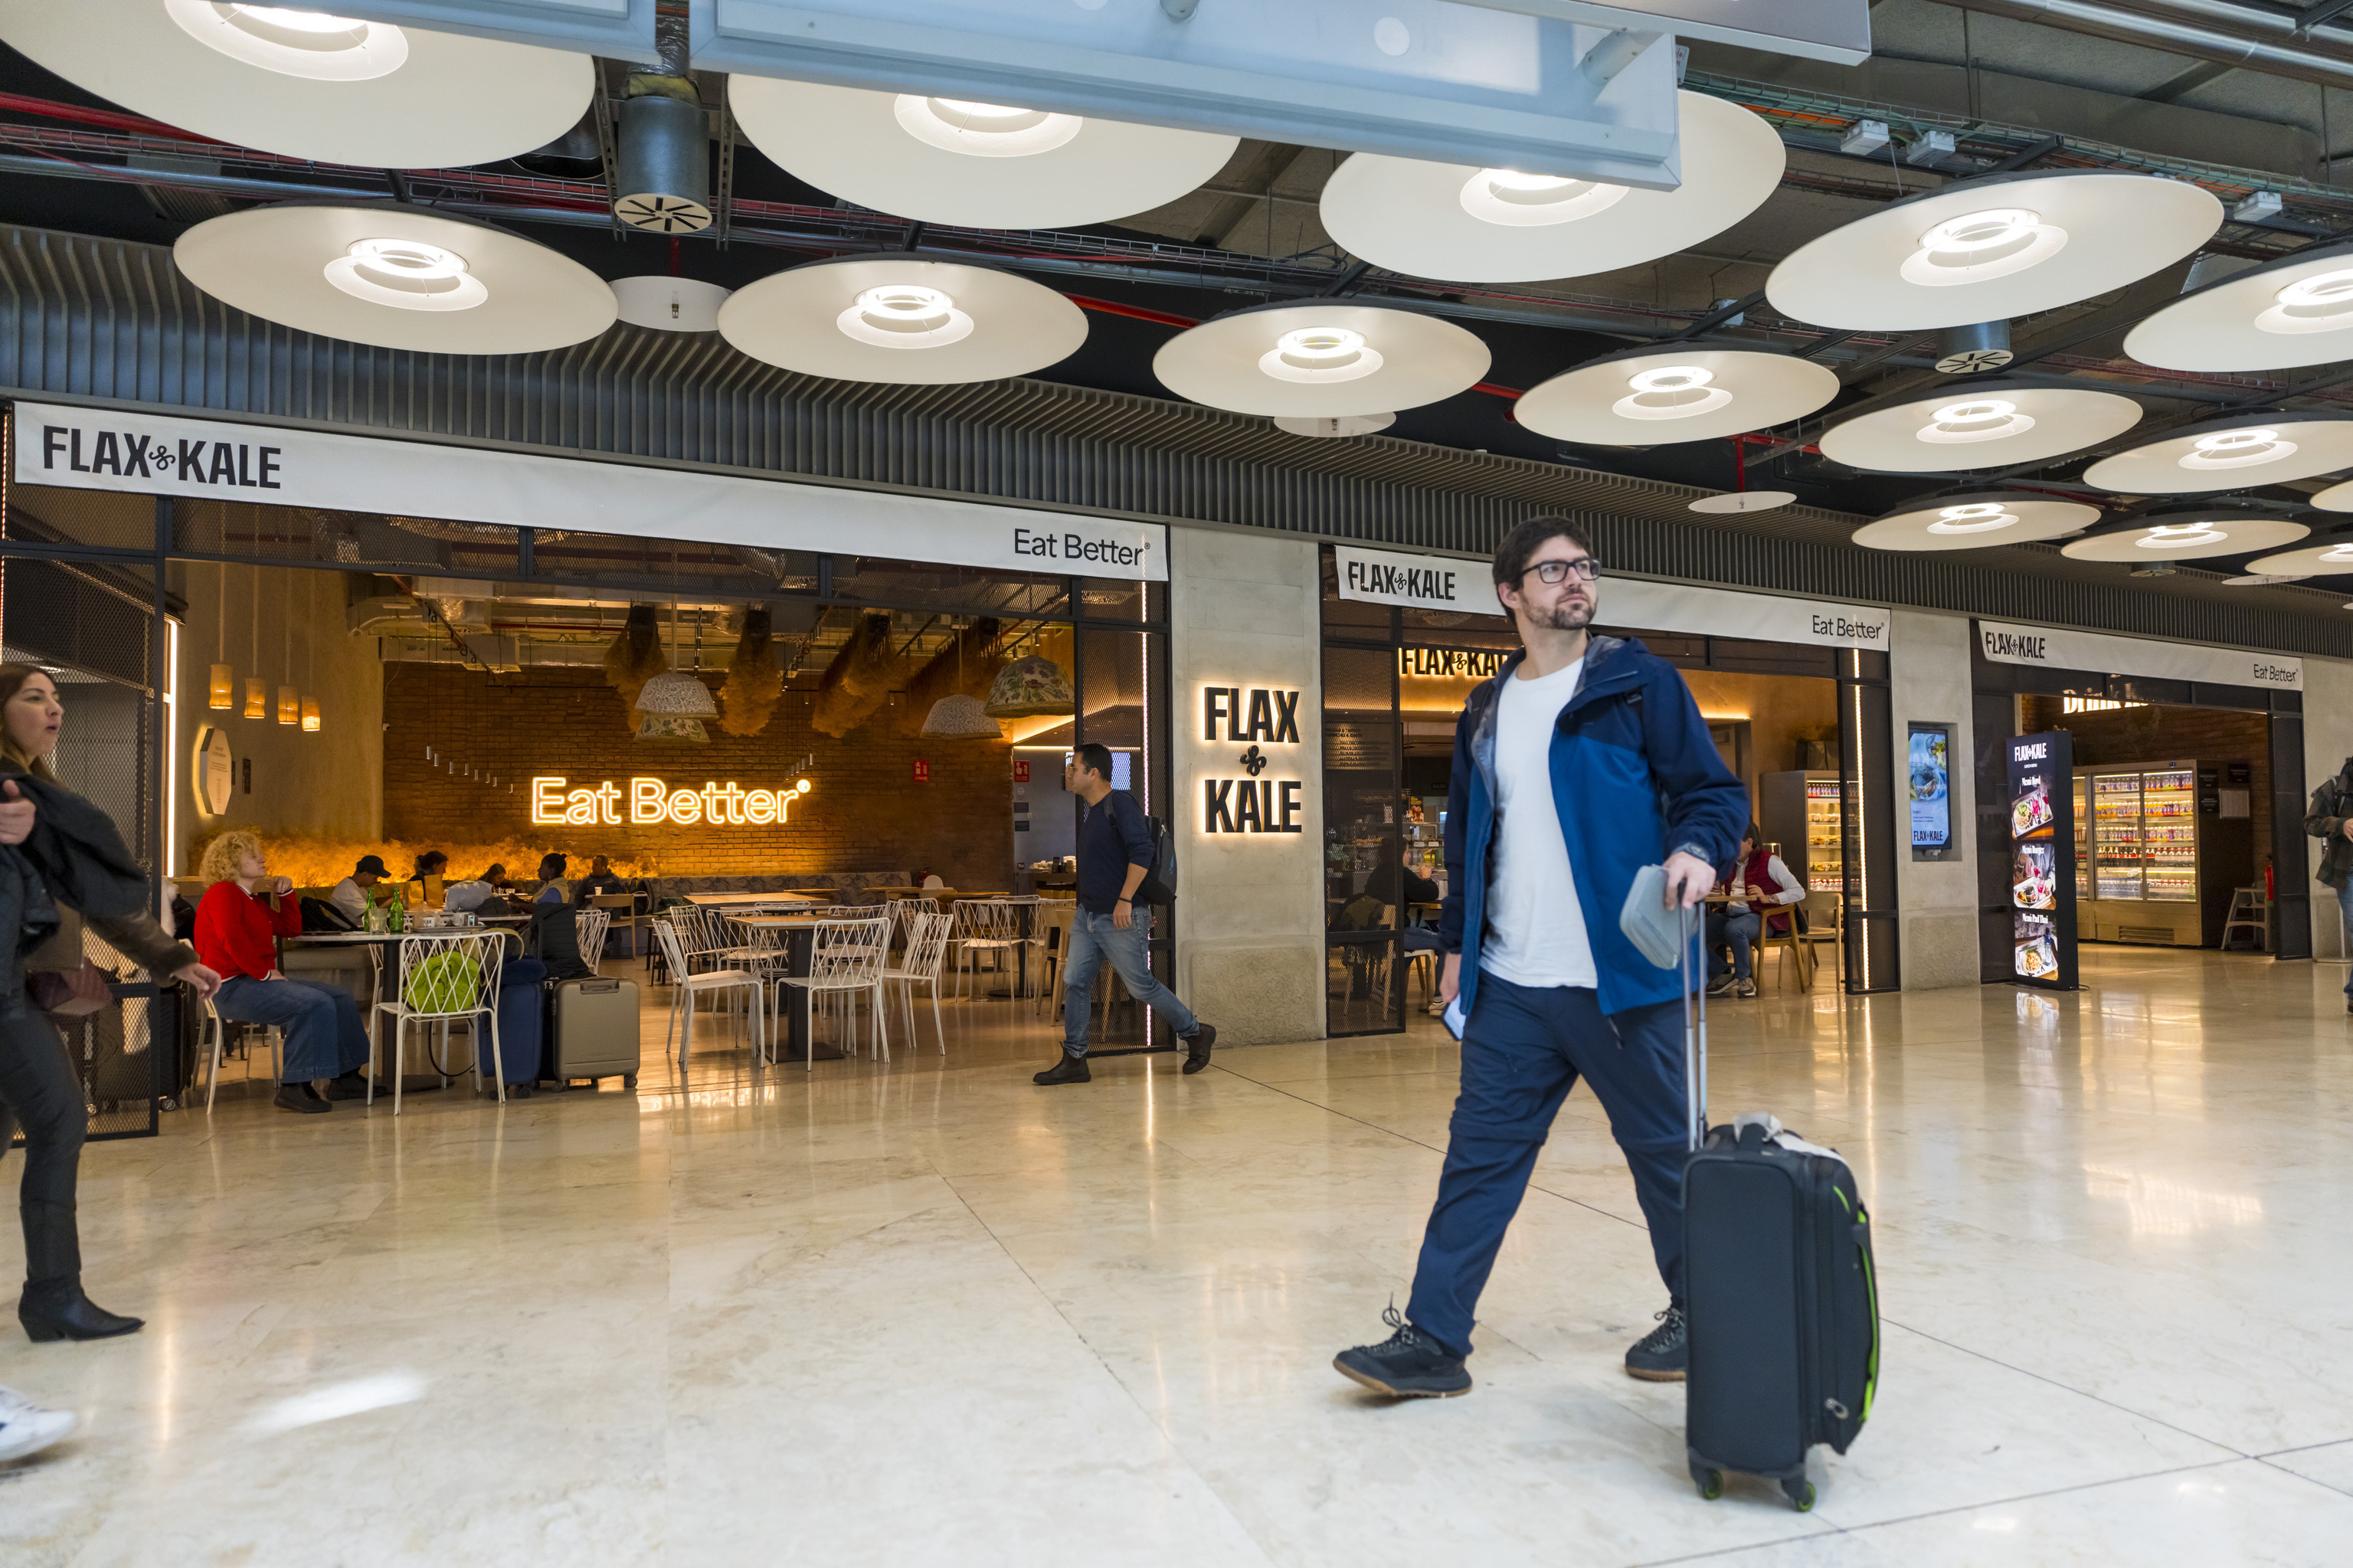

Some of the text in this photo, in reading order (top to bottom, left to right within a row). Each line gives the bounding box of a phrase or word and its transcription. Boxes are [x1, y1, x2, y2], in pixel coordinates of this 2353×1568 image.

[1015, 528, 1058, 558] Eat
[1812, 614, 1834, 636] Eat
[2253, 663, 2268, 679] Eat
[1205, 686, 1300, 743] FLAX
[532, 777, 621, 825] Eat
[1205, 779, 1302, 833] KALE
